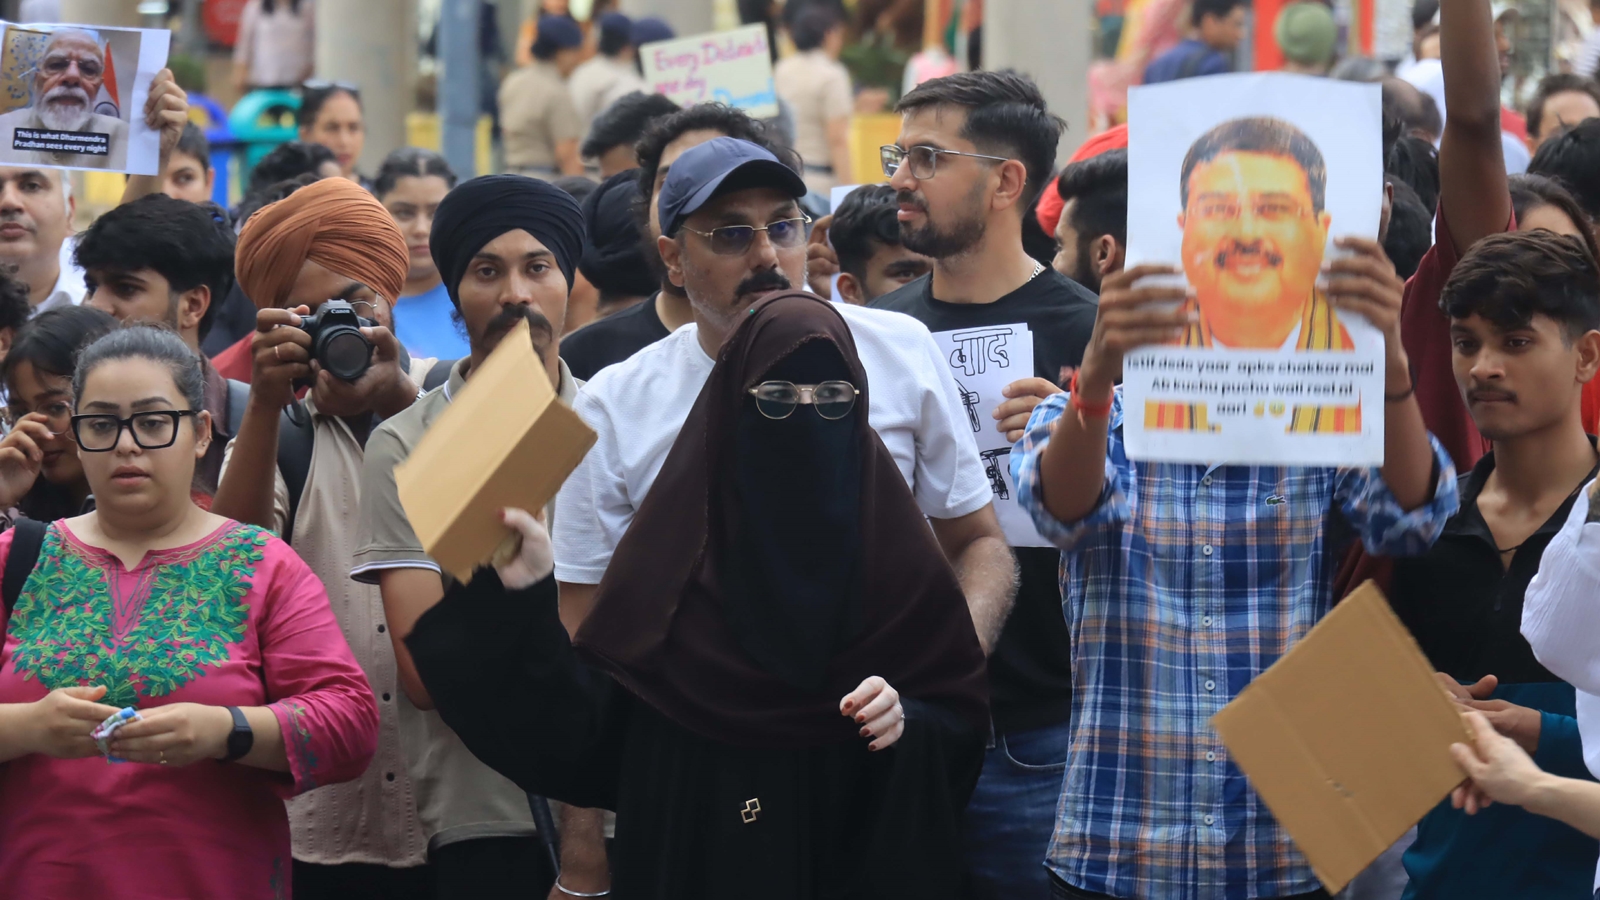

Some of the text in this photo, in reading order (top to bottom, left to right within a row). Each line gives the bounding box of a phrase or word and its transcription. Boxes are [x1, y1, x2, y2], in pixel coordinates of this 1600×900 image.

[654, 50, 699, 77] Every
[16, 131, 107, 143] This is what Dharmendra
[14, 140, 45, 148] Pradhan
[63, 144, 85, 153] every
[86, 145, 107, 154] night
[1197, 359, 1229, 376] yaar
[1238, 359, 1275, 377] apke
[1279, 359, 1340, 375] chakkar
[1152, 377, 1170, 392] Ab
[1173, 378, 1218, 393] kuchu
[1221, 380, 1269, 398] puchu
